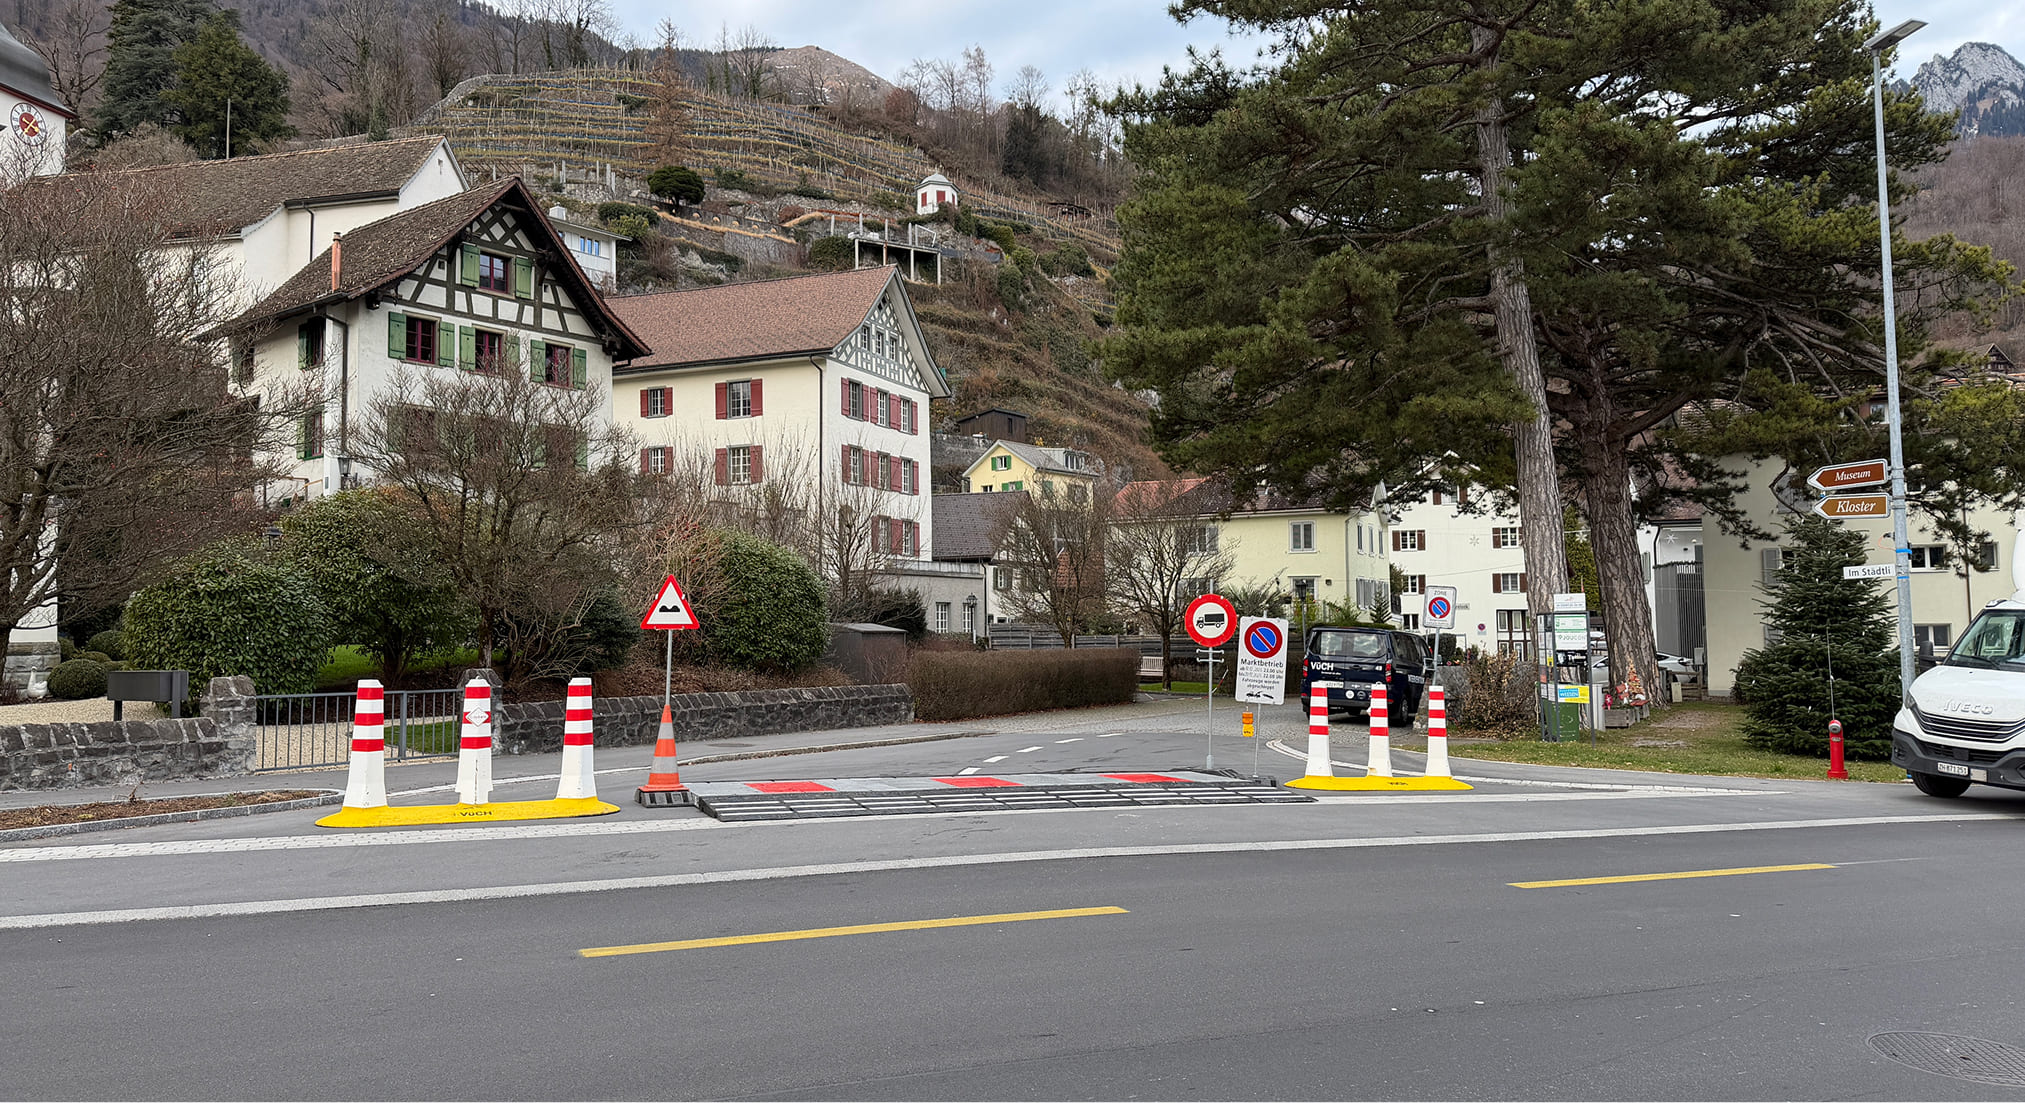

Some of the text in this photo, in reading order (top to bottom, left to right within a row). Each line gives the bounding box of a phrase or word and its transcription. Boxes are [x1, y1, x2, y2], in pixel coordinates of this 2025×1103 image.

[1834, 470, 1871, 482] Museum
[1836, 500, 1876, 513] Kloster
[1848, 569, 1859, 577] Im
[1240, 658, 1284, 668] Marktbetrieb
[1944, 698, 1993, 715] IVECO
